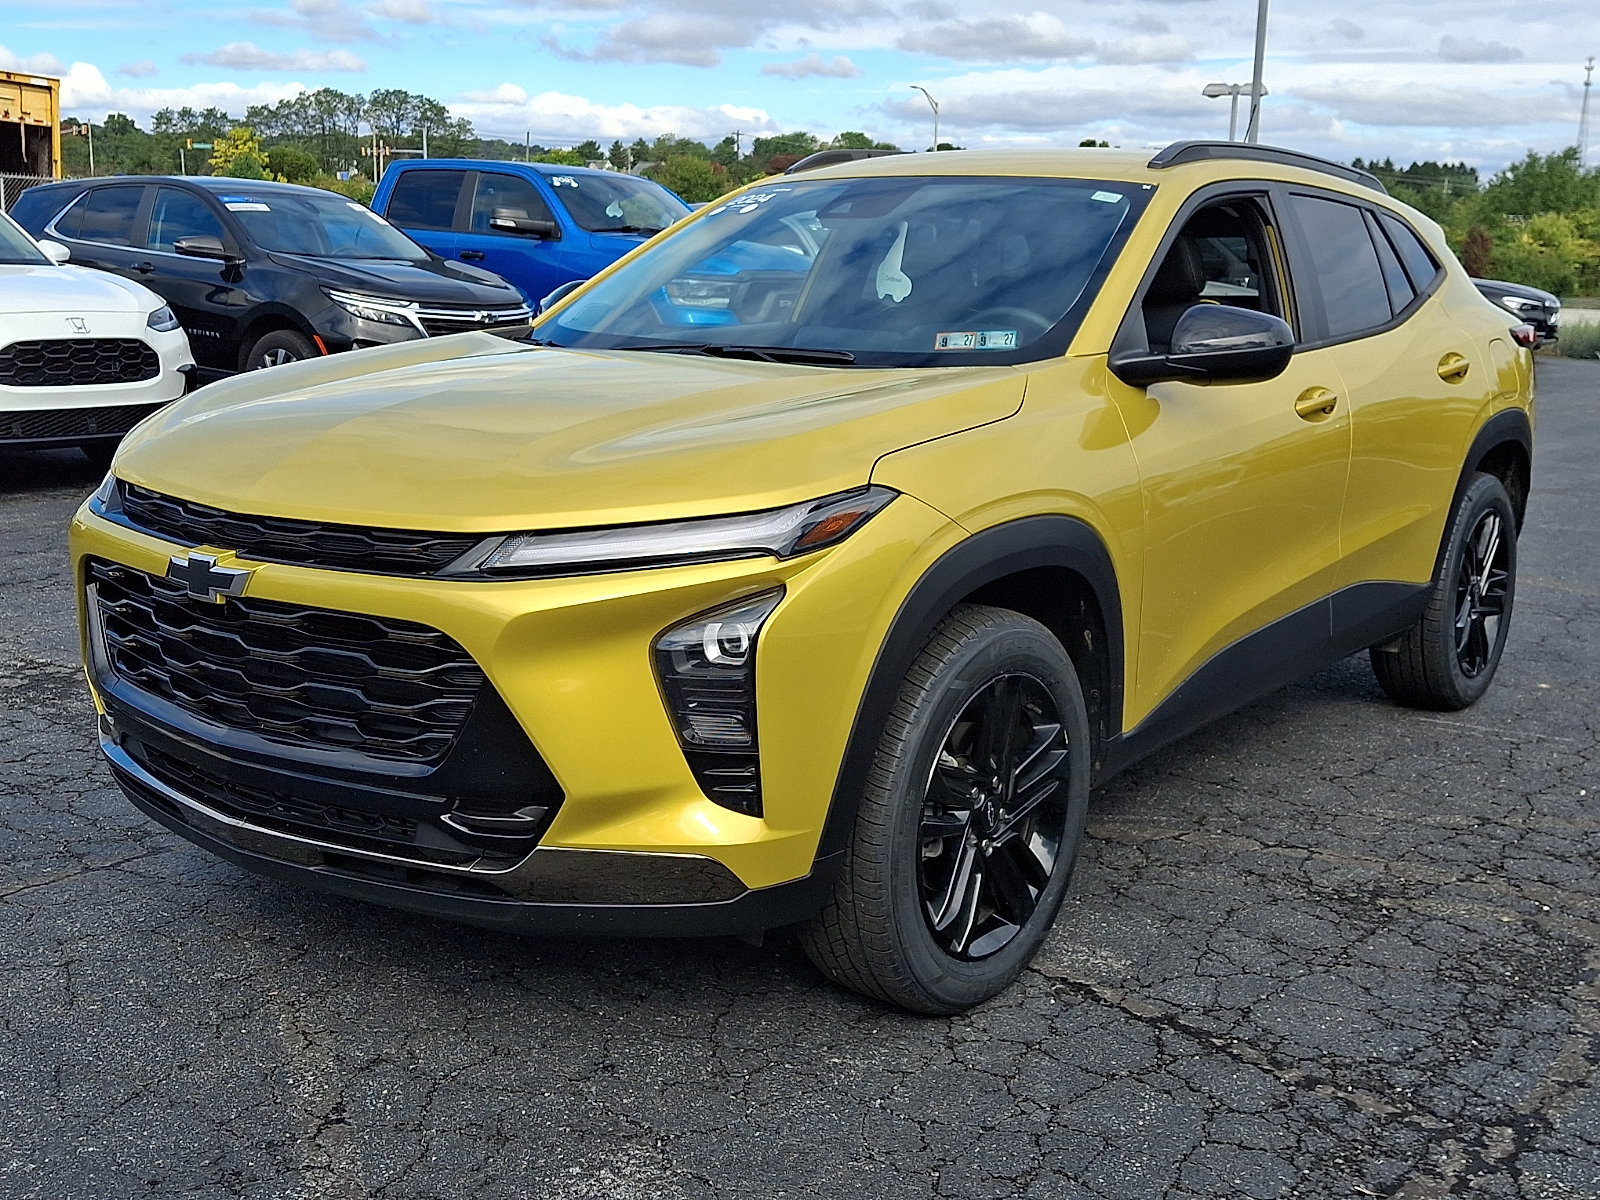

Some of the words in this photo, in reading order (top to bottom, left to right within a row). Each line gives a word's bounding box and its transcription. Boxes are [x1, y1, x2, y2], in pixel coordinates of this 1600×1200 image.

[941, 337, 948, 347] 9
[964, 334, 974, 346] 27
[979, 335, 987, 346] 9
[1004, 333, 1014, 345] 27
